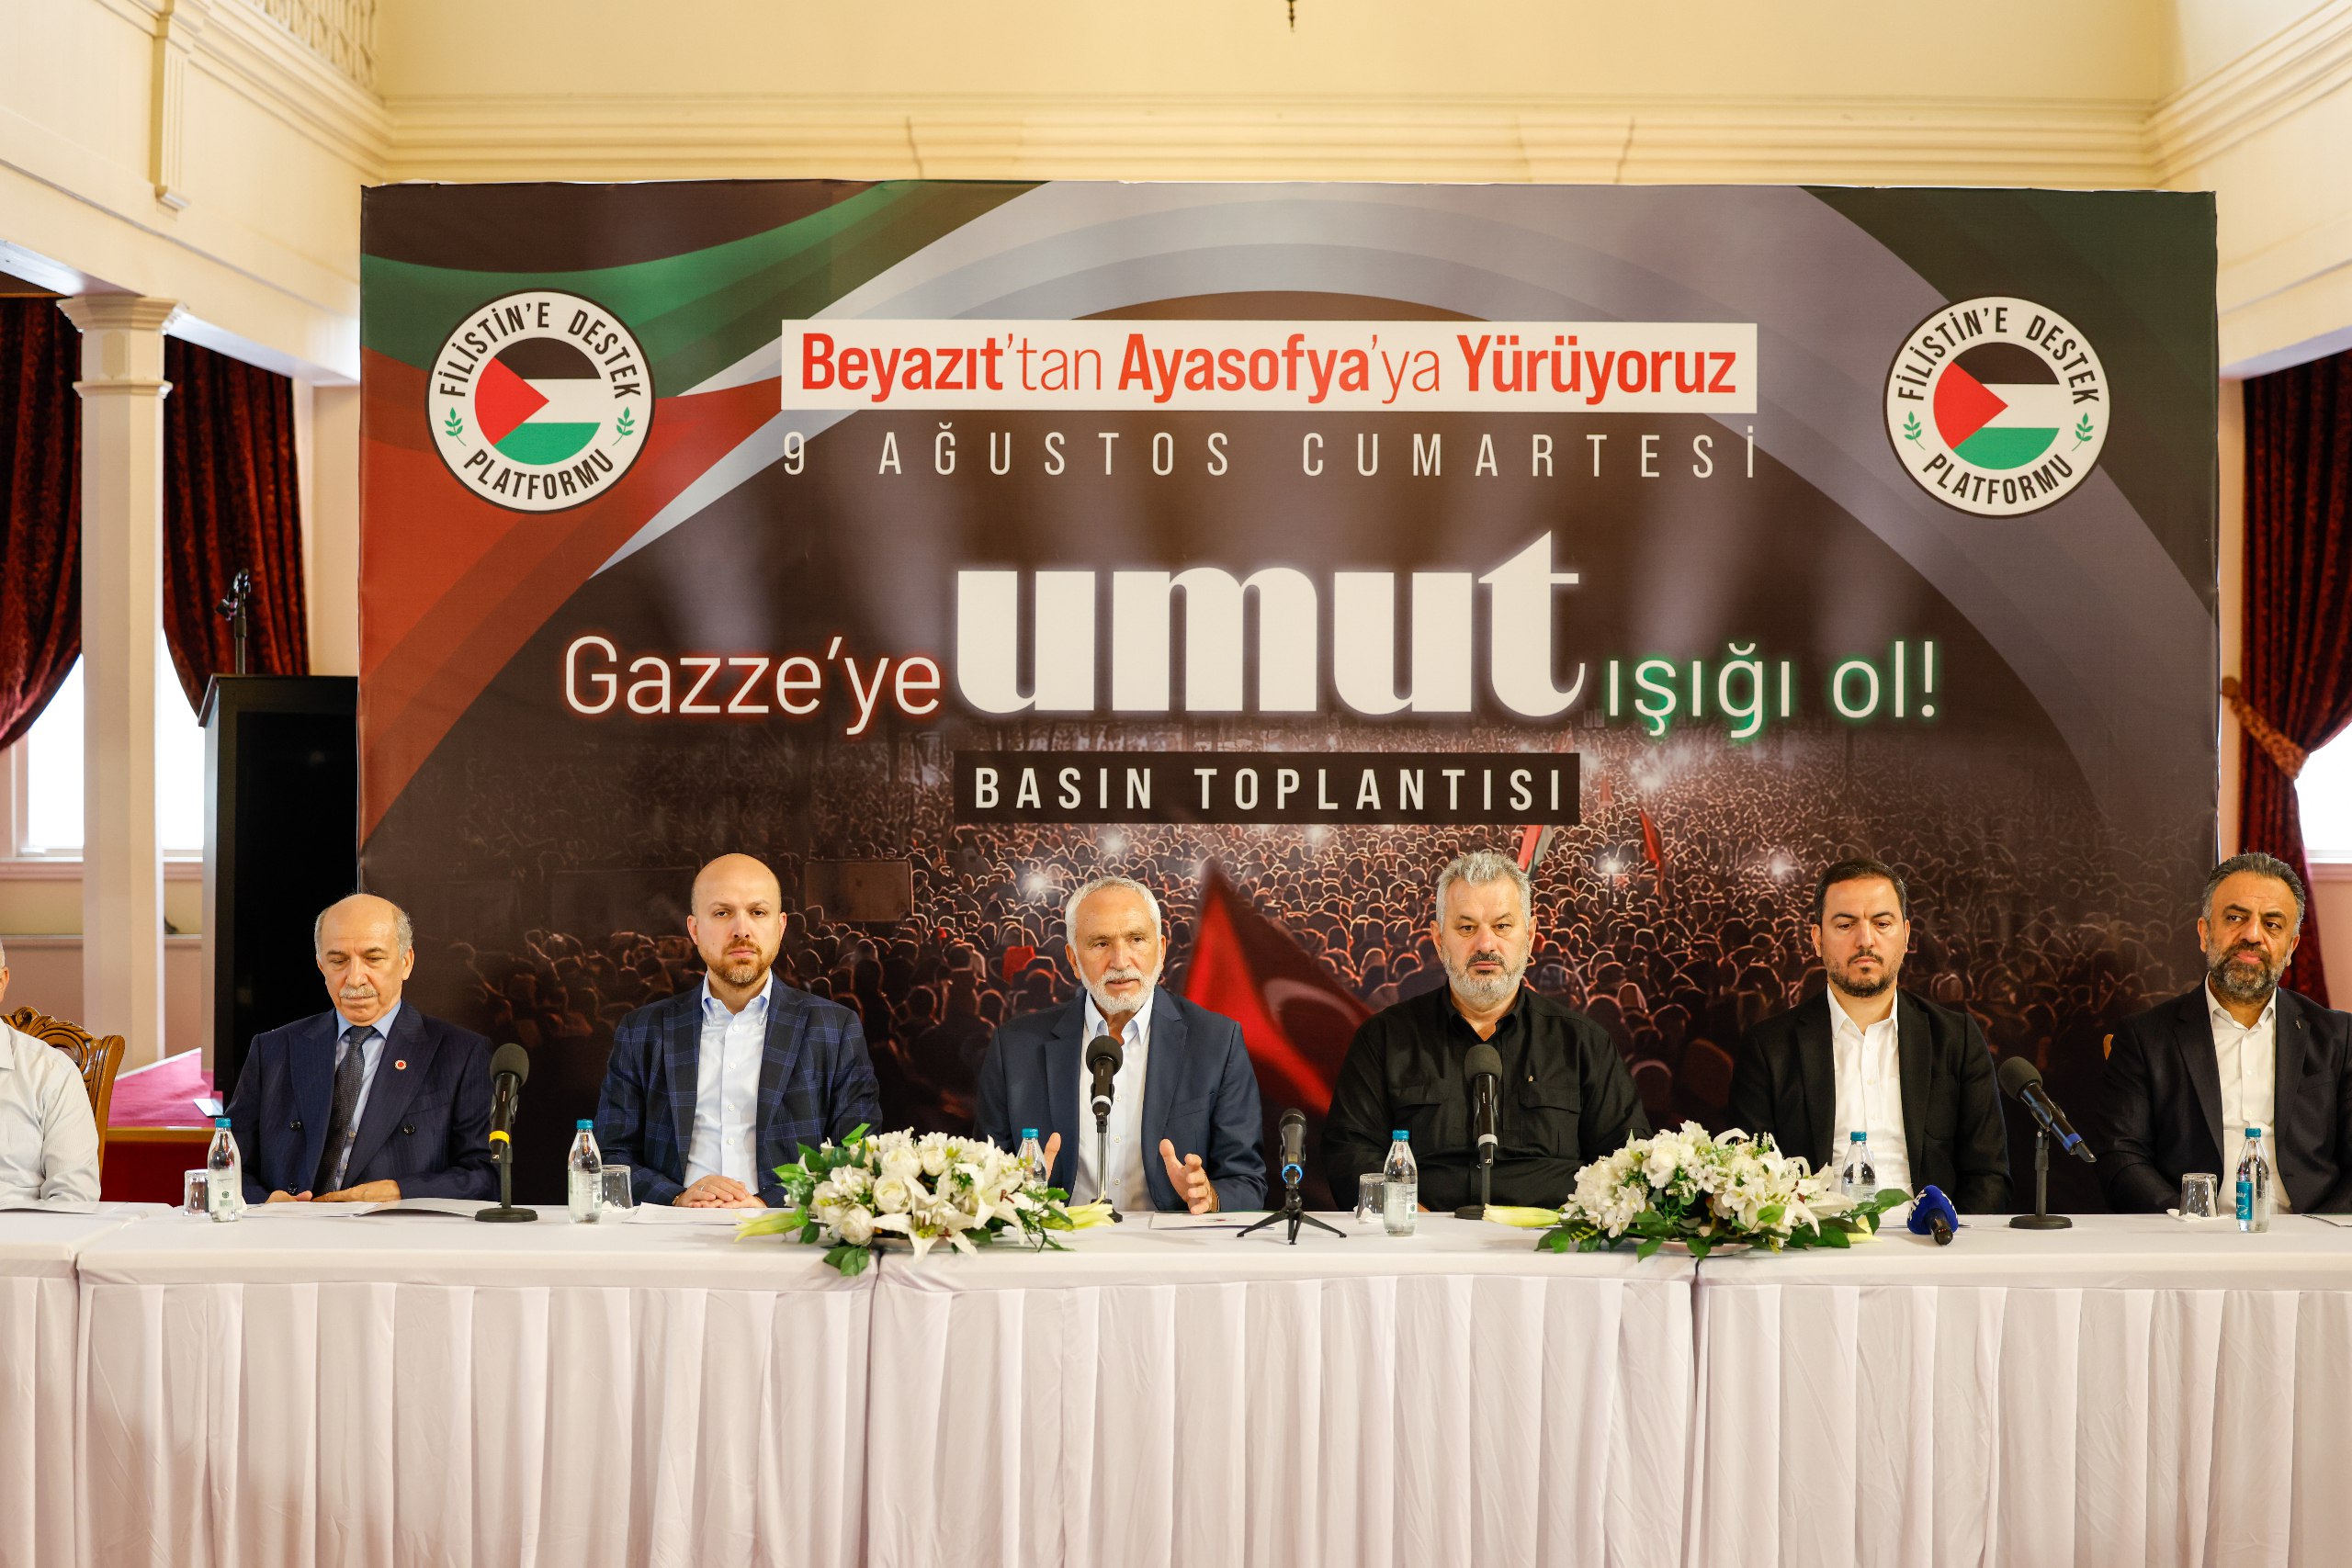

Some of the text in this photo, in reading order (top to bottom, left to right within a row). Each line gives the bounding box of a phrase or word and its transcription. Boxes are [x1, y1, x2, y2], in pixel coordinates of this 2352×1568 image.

[439, 302, 641, 399] FİLİSTİN'E DESTEK
[801, 332, 1737, 405] Beyazıt'tan Ayasofya'ya Yürüyoruz
[1895, 307, 2100, 405] FİLİSTİN'E DESTEK
[463, 448, 614, 500] PLATFORMU
[783, 422, 1755, 479] 9 AĞUSTOS CUMARTESİ
[1922, 453, 2074, 504] PLATFORMU
[565, 531, 1935, 739] Gazze'ye umut ışığı ol!
[976, 767, 1560, 811] BASIN TOPLANTISI
